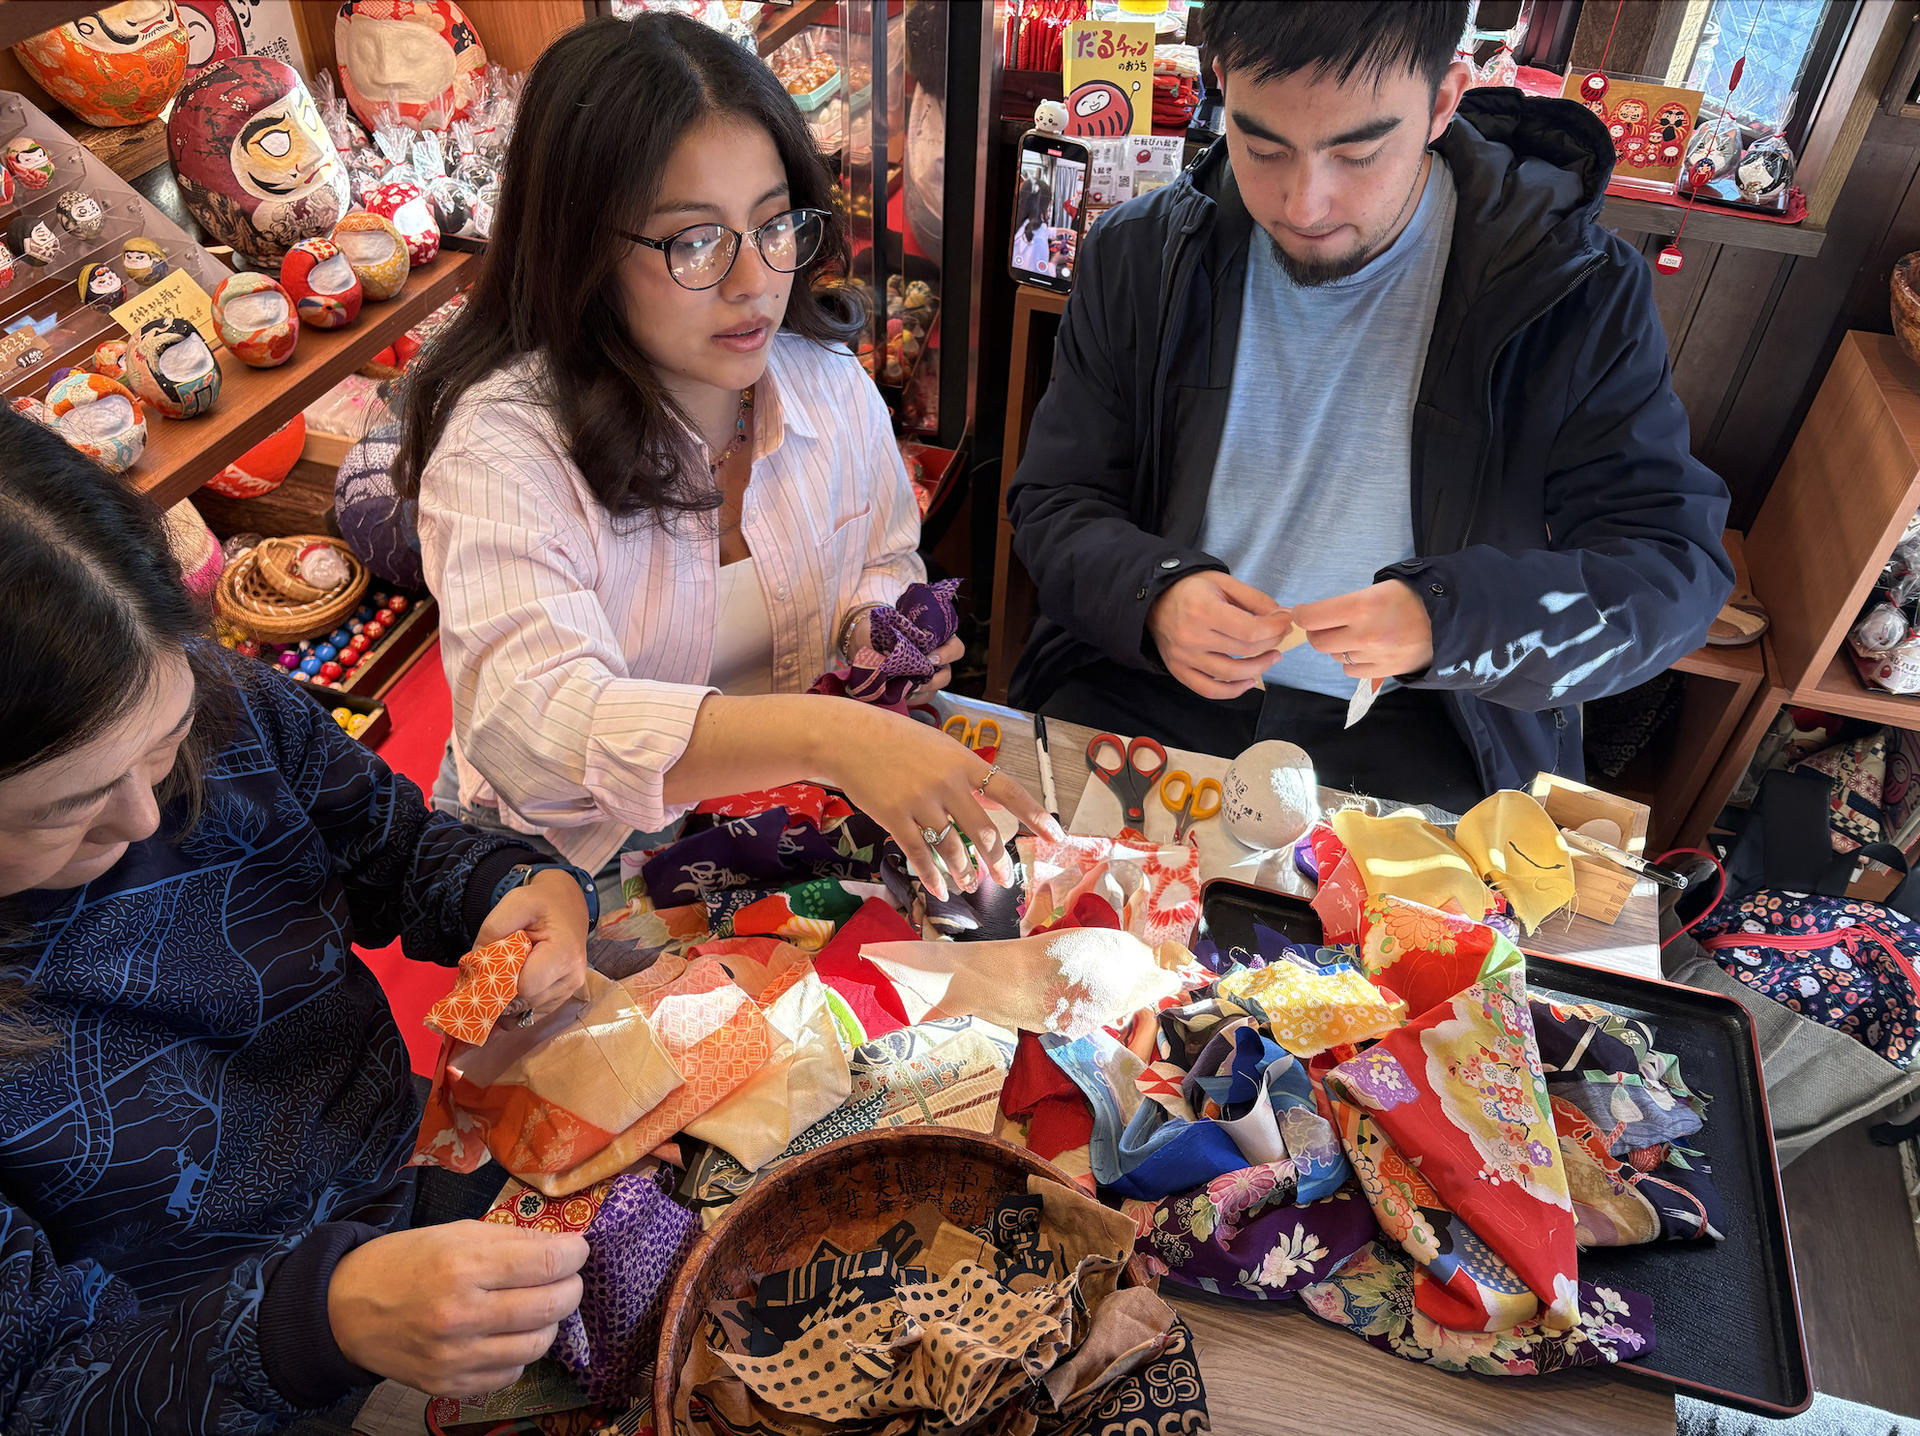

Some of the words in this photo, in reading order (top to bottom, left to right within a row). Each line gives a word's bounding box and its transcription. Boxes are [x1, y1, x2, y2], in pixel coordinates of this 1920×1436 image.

[1077, 30, 1148, 59] だるチャン
[1118, 60, 1147, 72] のおうち
[1134, 138, 1178, 148] 七転び八起き
